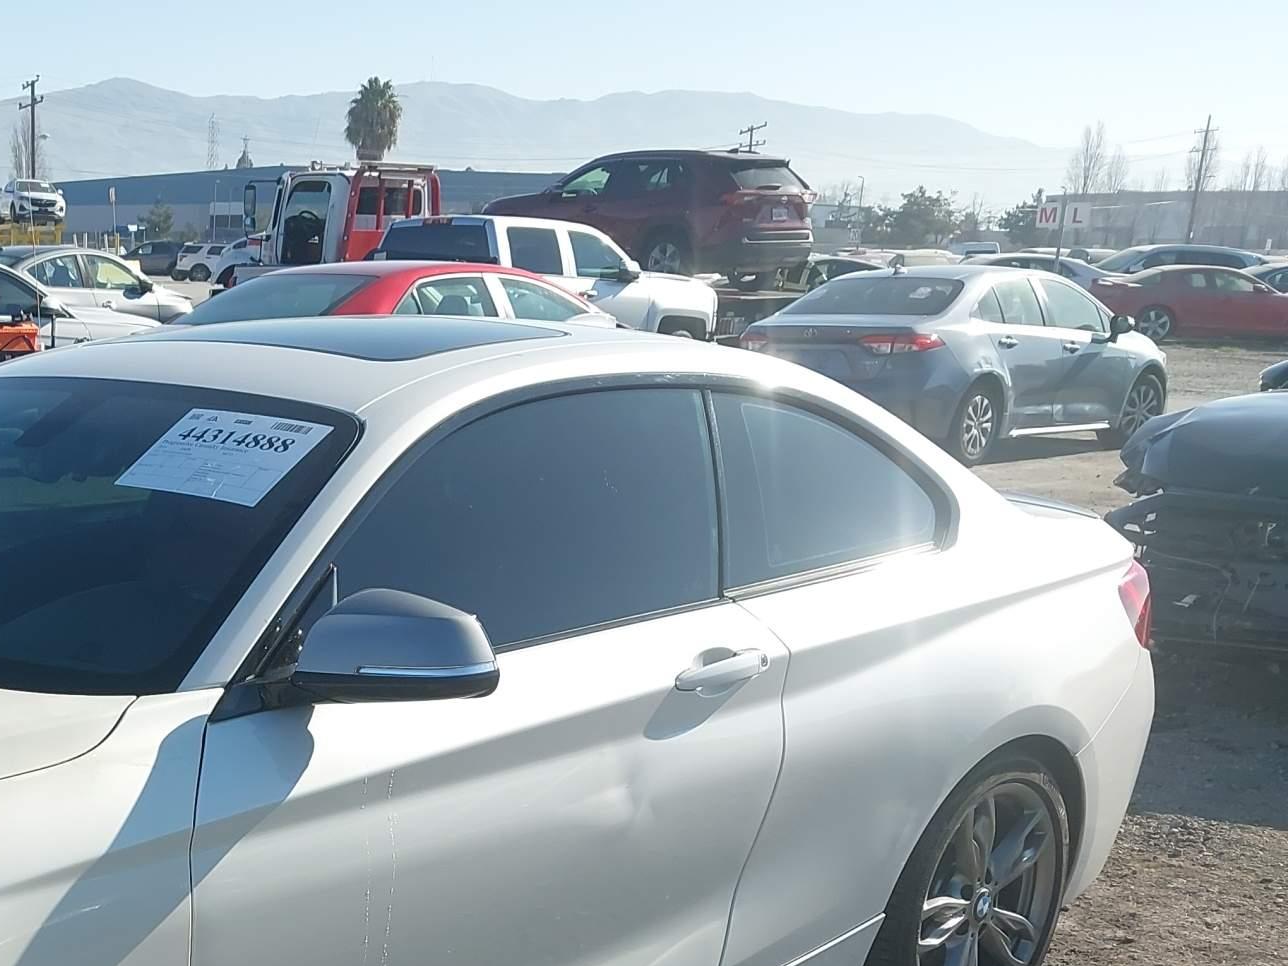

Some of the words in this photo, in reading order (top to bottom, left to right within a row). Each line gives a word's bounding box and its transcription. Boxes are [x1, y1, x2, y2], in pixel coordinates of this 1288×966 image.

[1039, 207, 1058, 224] M
[1072, 207, 1083, 224] L
[178, 426, 295, 453] 44314888
